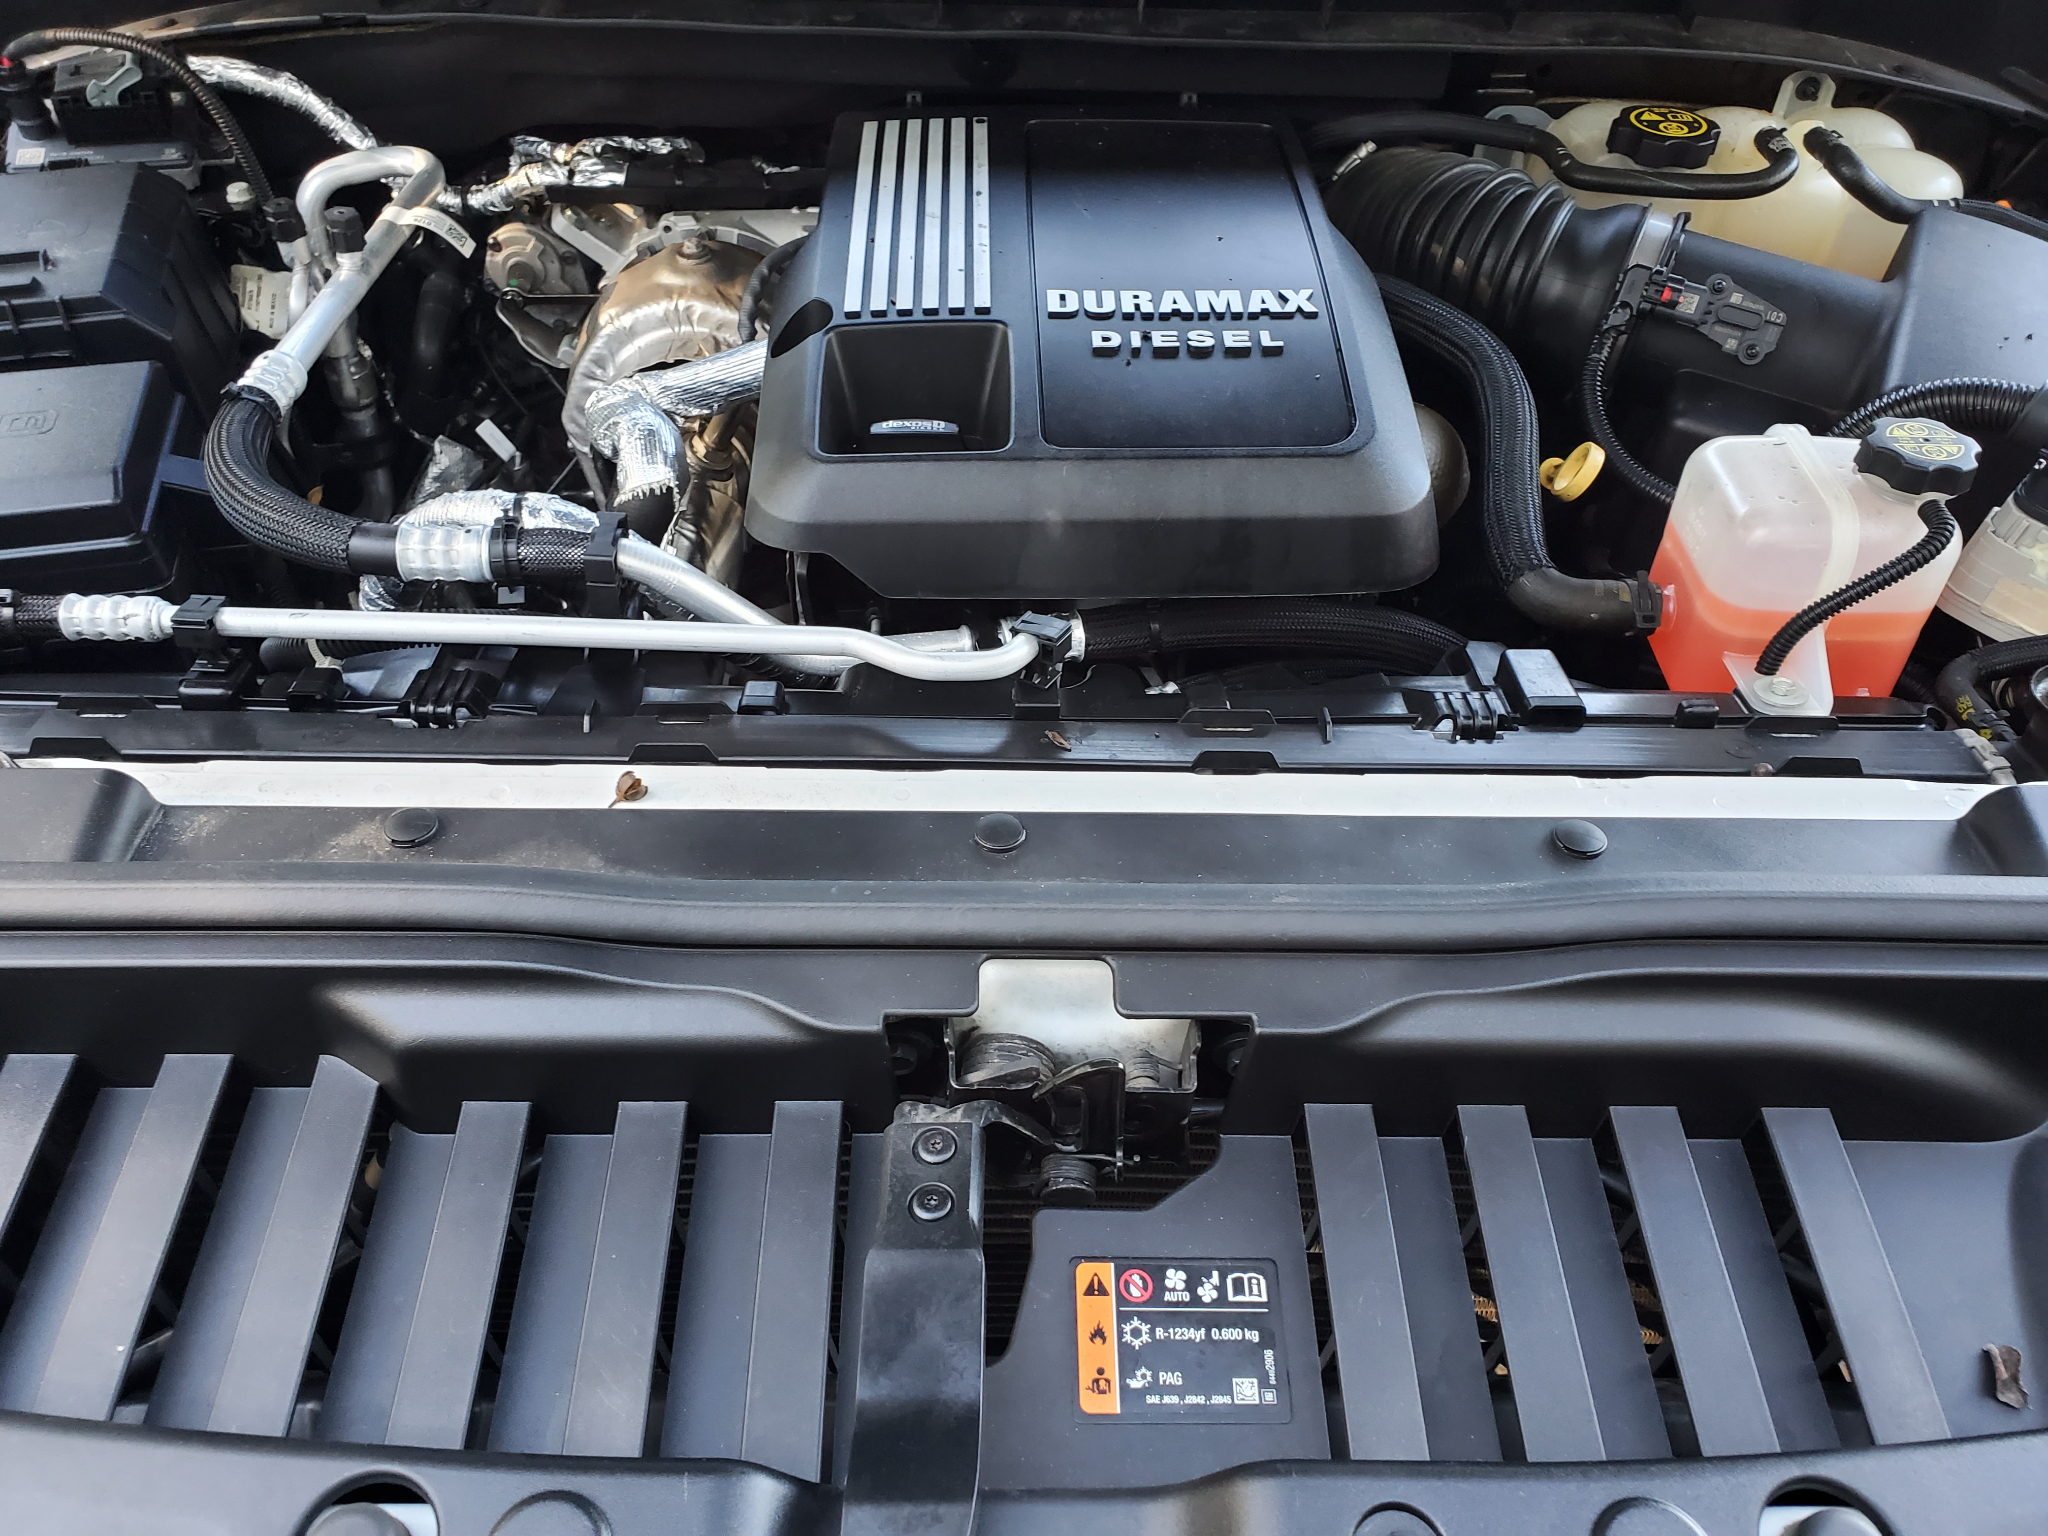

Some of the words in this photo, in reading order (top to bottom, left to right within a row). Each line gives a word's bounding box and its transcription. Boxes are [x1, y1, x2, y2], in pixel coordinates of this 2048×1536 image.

[1046, 288, 1319, 319] DURAMAX
[1091, 330, 1285, 355] DIESEL
[1164, 1291, 1190, 1302] AUTO
[1155, 1328, 1206, 1342] R-1234yf
[1211, 1328, 1242, 1340] 0.600
[1244, 1328, 1260, 1343] kg
[1159, 1371, 1183, 1385] PAG
[1145, 1395, 1160, 1404] SAE
